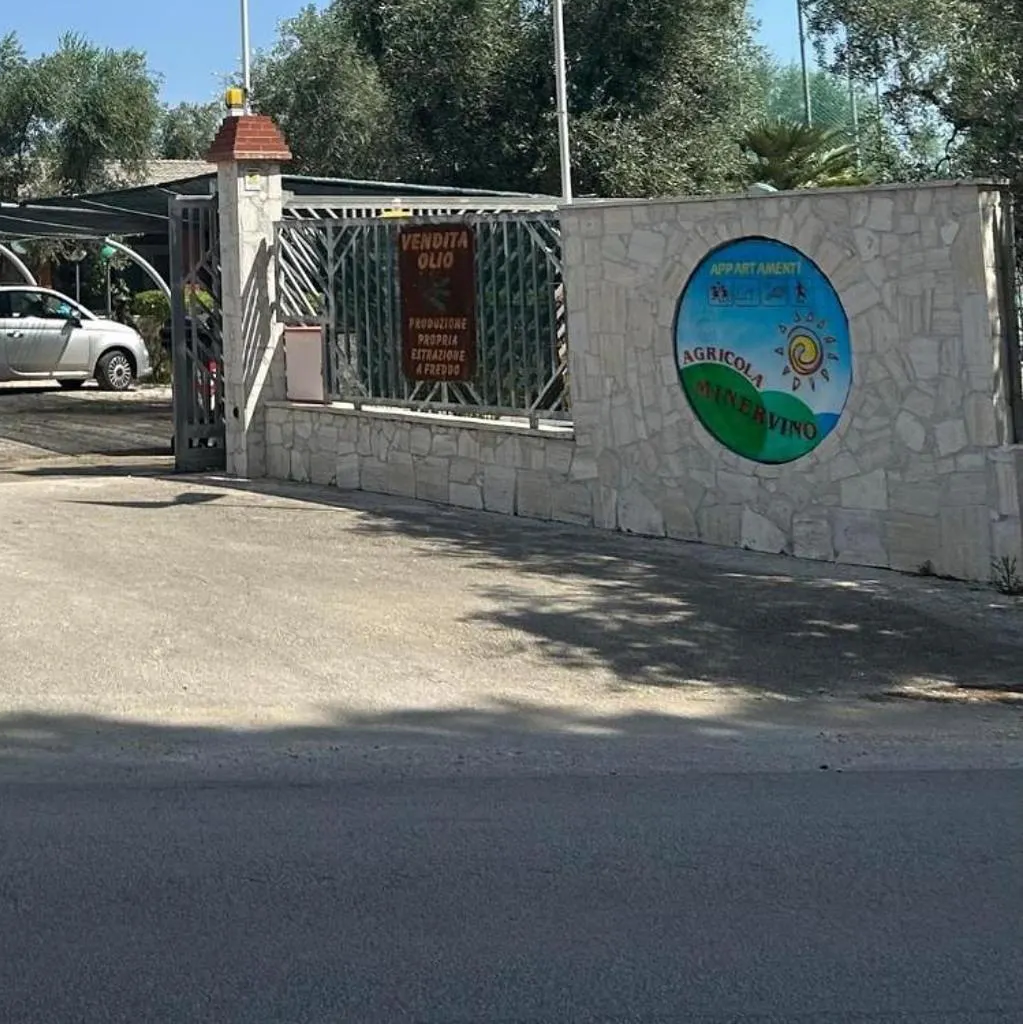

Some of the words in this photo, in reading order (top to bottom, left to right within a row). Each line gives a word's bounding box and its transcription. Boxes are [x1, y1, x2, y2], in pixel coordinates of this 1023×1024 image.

[401, 231, 468, 251] VENDITA
[417, 252, 454, 269] OLIO
[409, 317, 467, 330] PRODUZIONE
[417, 334, 458, 346] PROPRIA
[424, 363, 461, 376] FREDDO
[683, 346, 764, 389] AGRICOLA
[696, 378, 817, 441] MINERVINO
